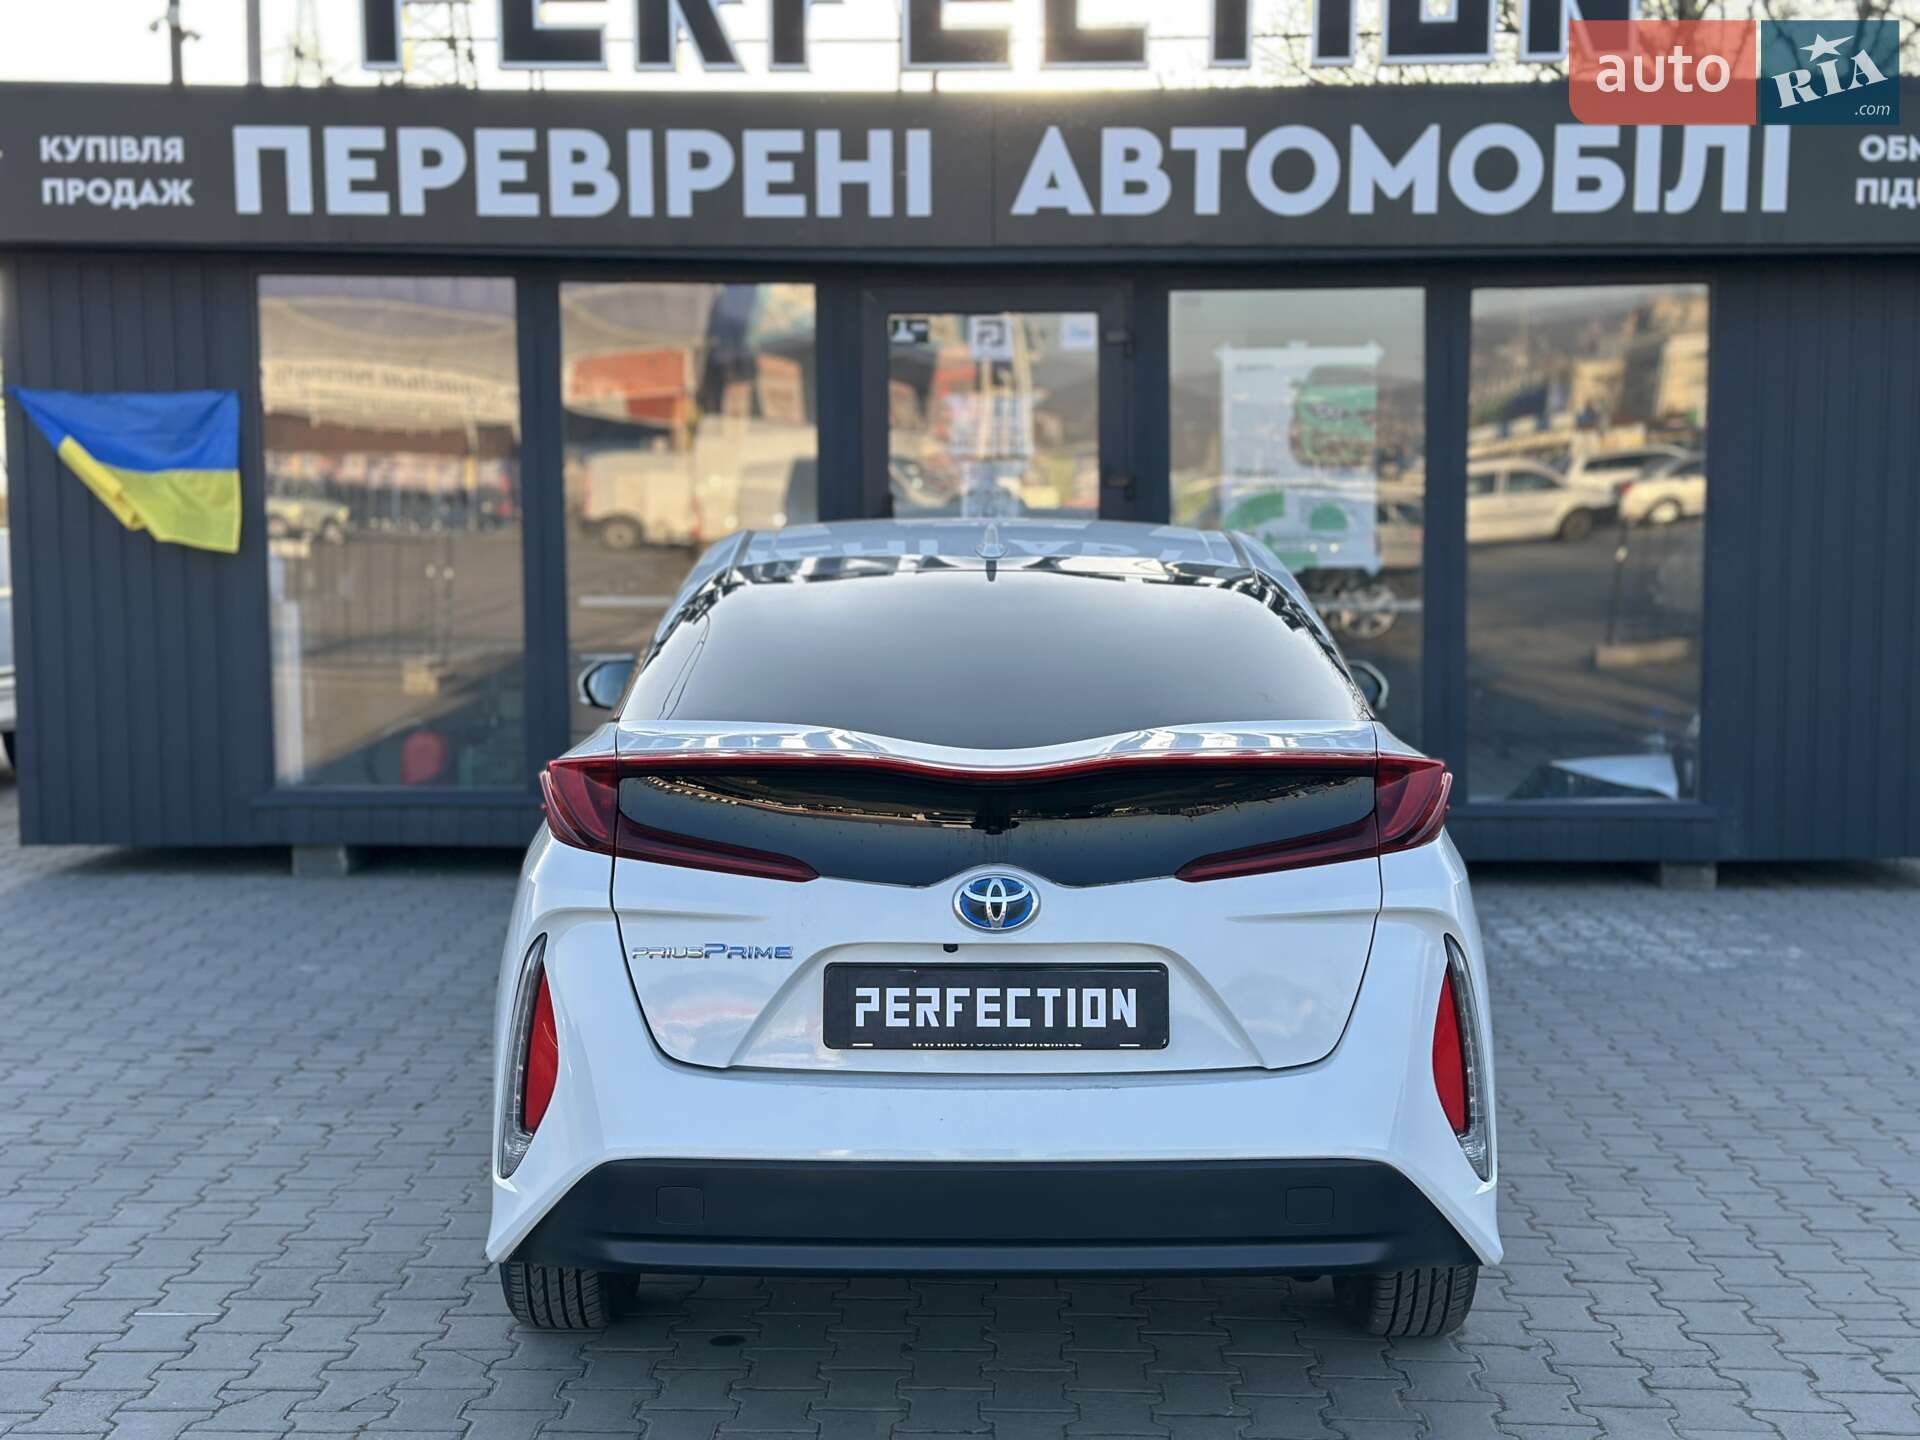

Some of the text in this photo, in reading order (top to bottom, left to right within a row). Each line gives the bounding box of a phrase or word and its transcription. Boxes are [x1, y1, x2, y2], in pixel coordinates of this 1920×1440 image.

[39, 135, 184, 163] КУПІВЛЯ
[232, 124, 1791, 219] ПЕРЕВІРЕНІ АВТОМОБІЛІ
[41, 177, 195, 210] ПРОДАЖ
[1855, 177, 1920, 209] ПІД
[855, 987, 1137, 1028] PERFECTION
